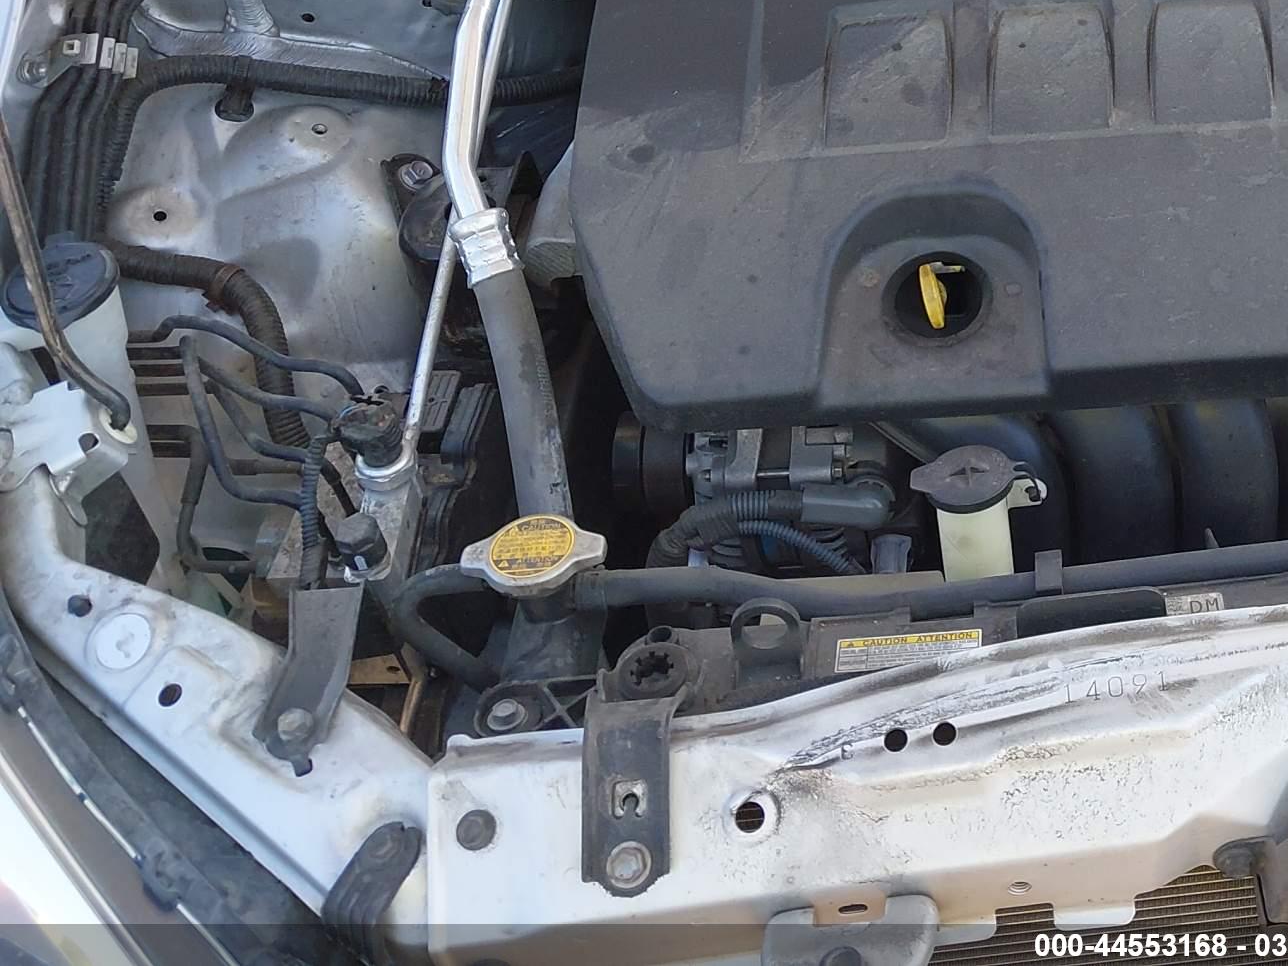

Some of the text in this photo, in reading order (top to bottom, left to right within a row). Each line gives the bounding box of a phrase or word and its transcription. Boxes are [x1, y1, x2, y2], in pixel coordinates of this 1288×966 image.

[1189, 597, 1220, 614] DM
[863, 631, 973, 646] CAUTION ATTENTION
[1065, 671, 1169, 704] 14091
